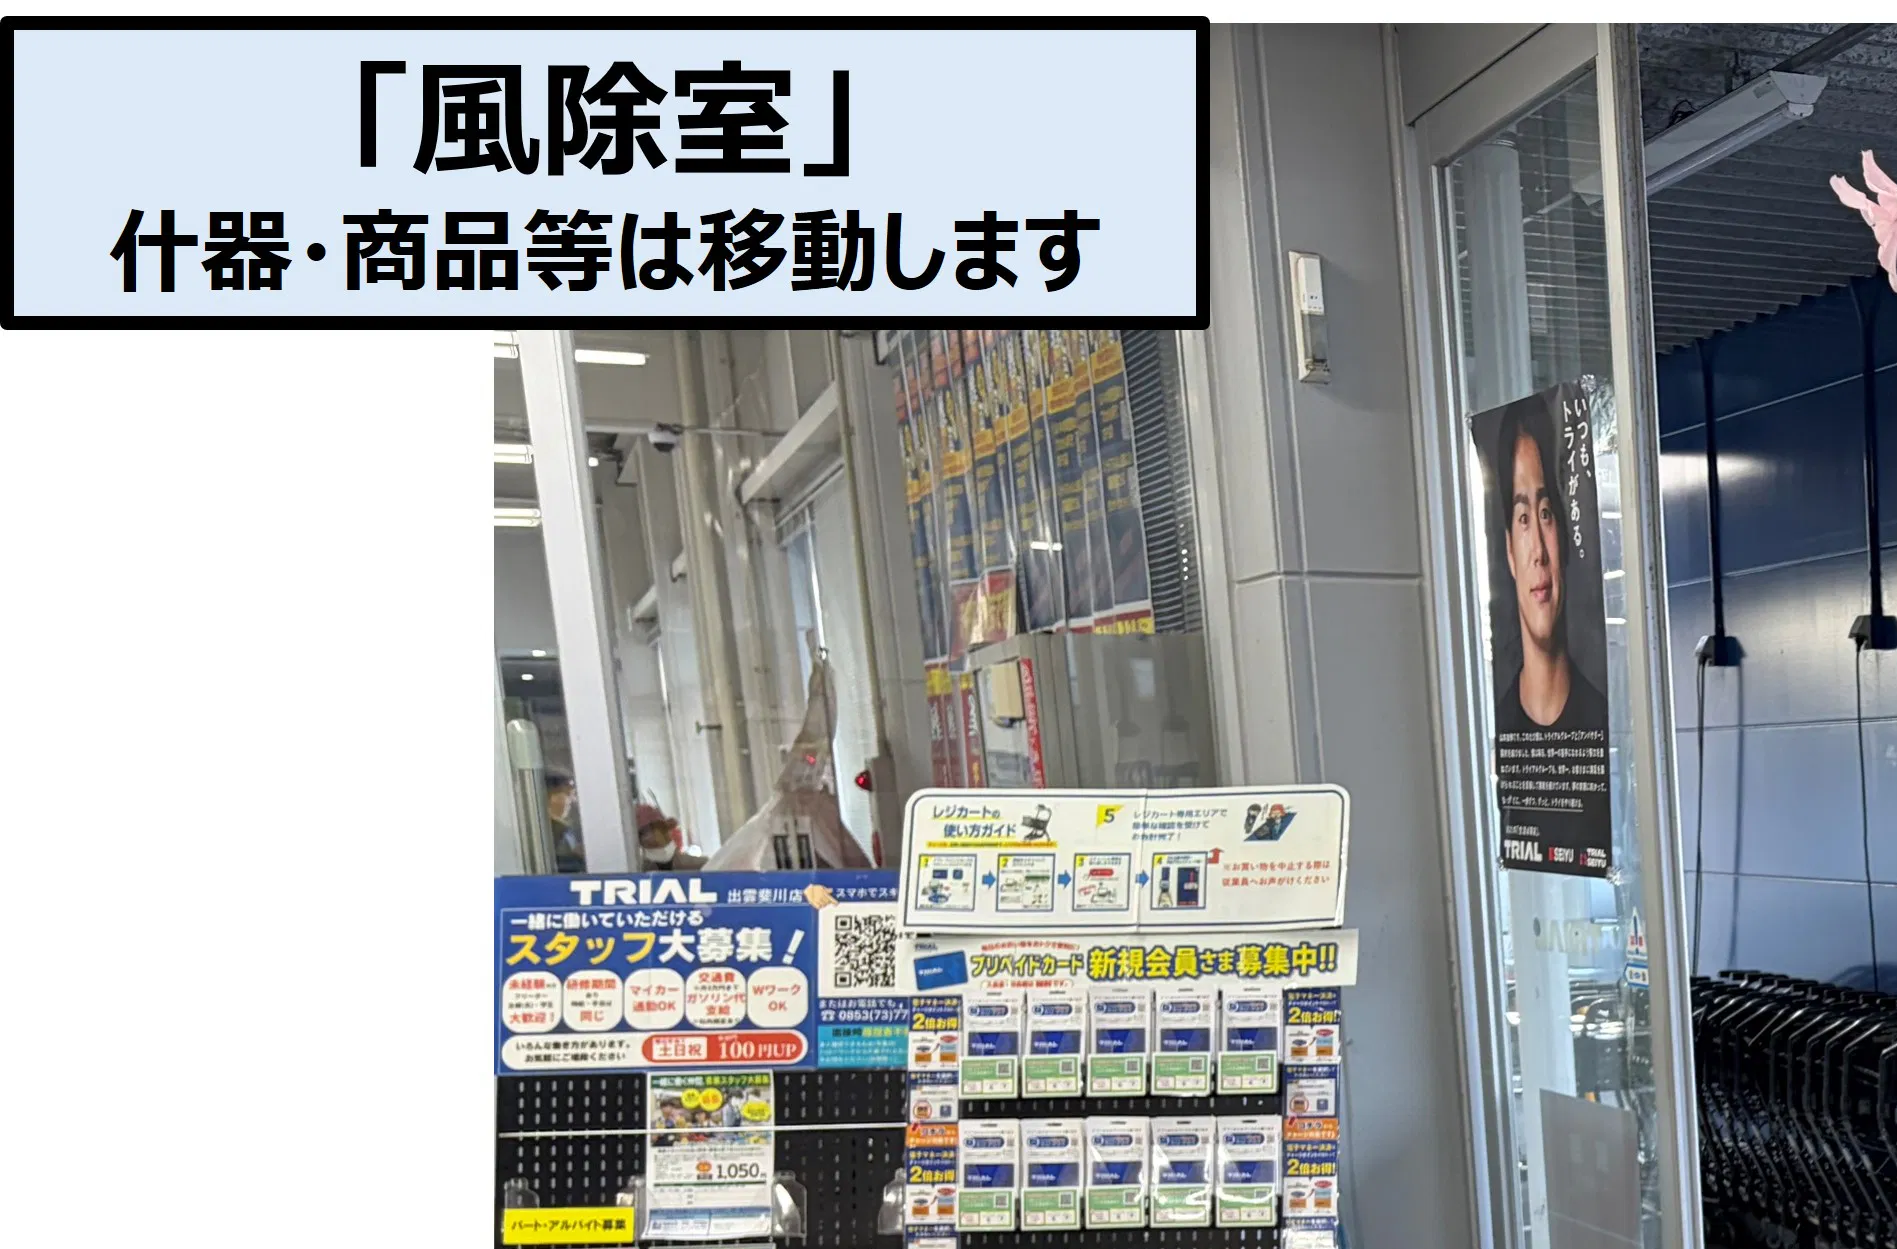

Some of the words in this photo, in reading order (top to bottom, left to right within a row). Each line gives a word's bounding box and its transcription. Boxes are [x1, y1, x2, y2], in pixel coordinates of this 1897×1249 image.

[1574, 398, 1593, 479] いつも、
[1562, 400, 1586, 560] トライがある。
[932, 805, 1000, 819] レジカートの
[1104, 808, 1115, 823] 5
[944, 823, 1016, 838] 使い方ガイド
[1504, 840, 1543, 863] TRIAL
[1554, 847, 1574, 863] SEIYU
[570, 878, 718, 906] TRIAL
[510, 910, 704, 930] 一緒に働いていただける
[506, 926, 805, 966] スタッフ大募集！
[971, 953, 1084, 977] プリペイドカード
[630, 985, 680, 996] マイカー
[752, 984, 802, 996] Wワーク
[768, 1000, 788, 1012] OK
[719, 1040, 797, 1059] 100円UP
[511, 1219, 627, 1231] パート・アルバイト募集
